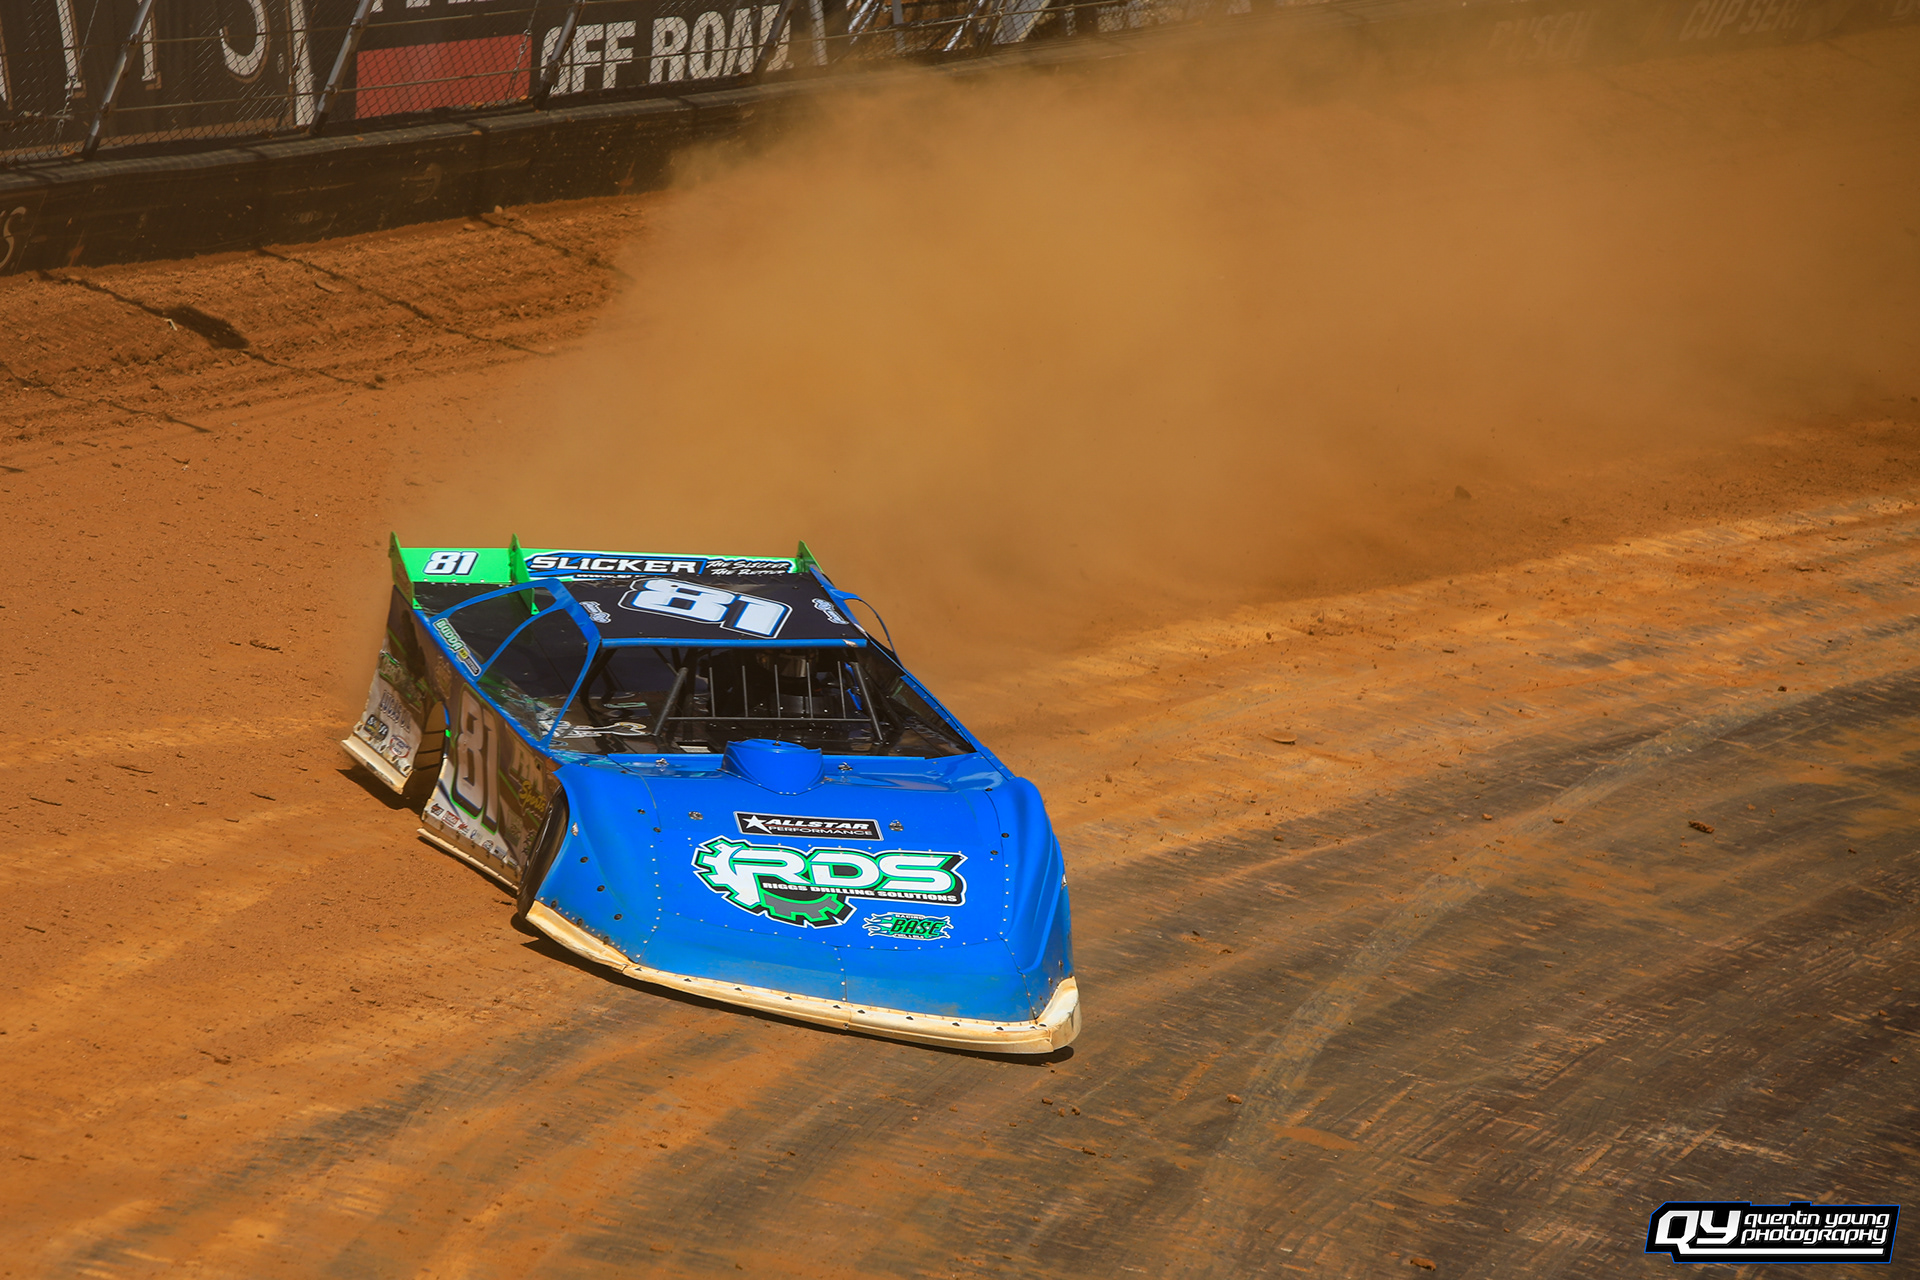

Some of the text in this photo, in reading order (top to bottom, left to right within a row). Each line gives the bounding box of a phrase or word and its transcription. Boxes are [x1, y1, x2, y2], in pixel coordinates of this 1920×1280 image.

[540, 21, 637, 95] OFF
[422, 550, 479, 576] 81
[530, 557, 698, 574] SLICKER
[627, 577, 790, 638] 81
[434, 619, 465, 651] BUDDA
[455, 688, 499, 828] 81
[766, 818, 870, 830] ALLSTAR
[768, 825, 873, 836] PERFORMANCE
[732, 850, 954, 905] RDS
[762, 881, 958, 903] RIGGS DRILLING SOLUTIONS
[890, 918, 945, 936] BASE
